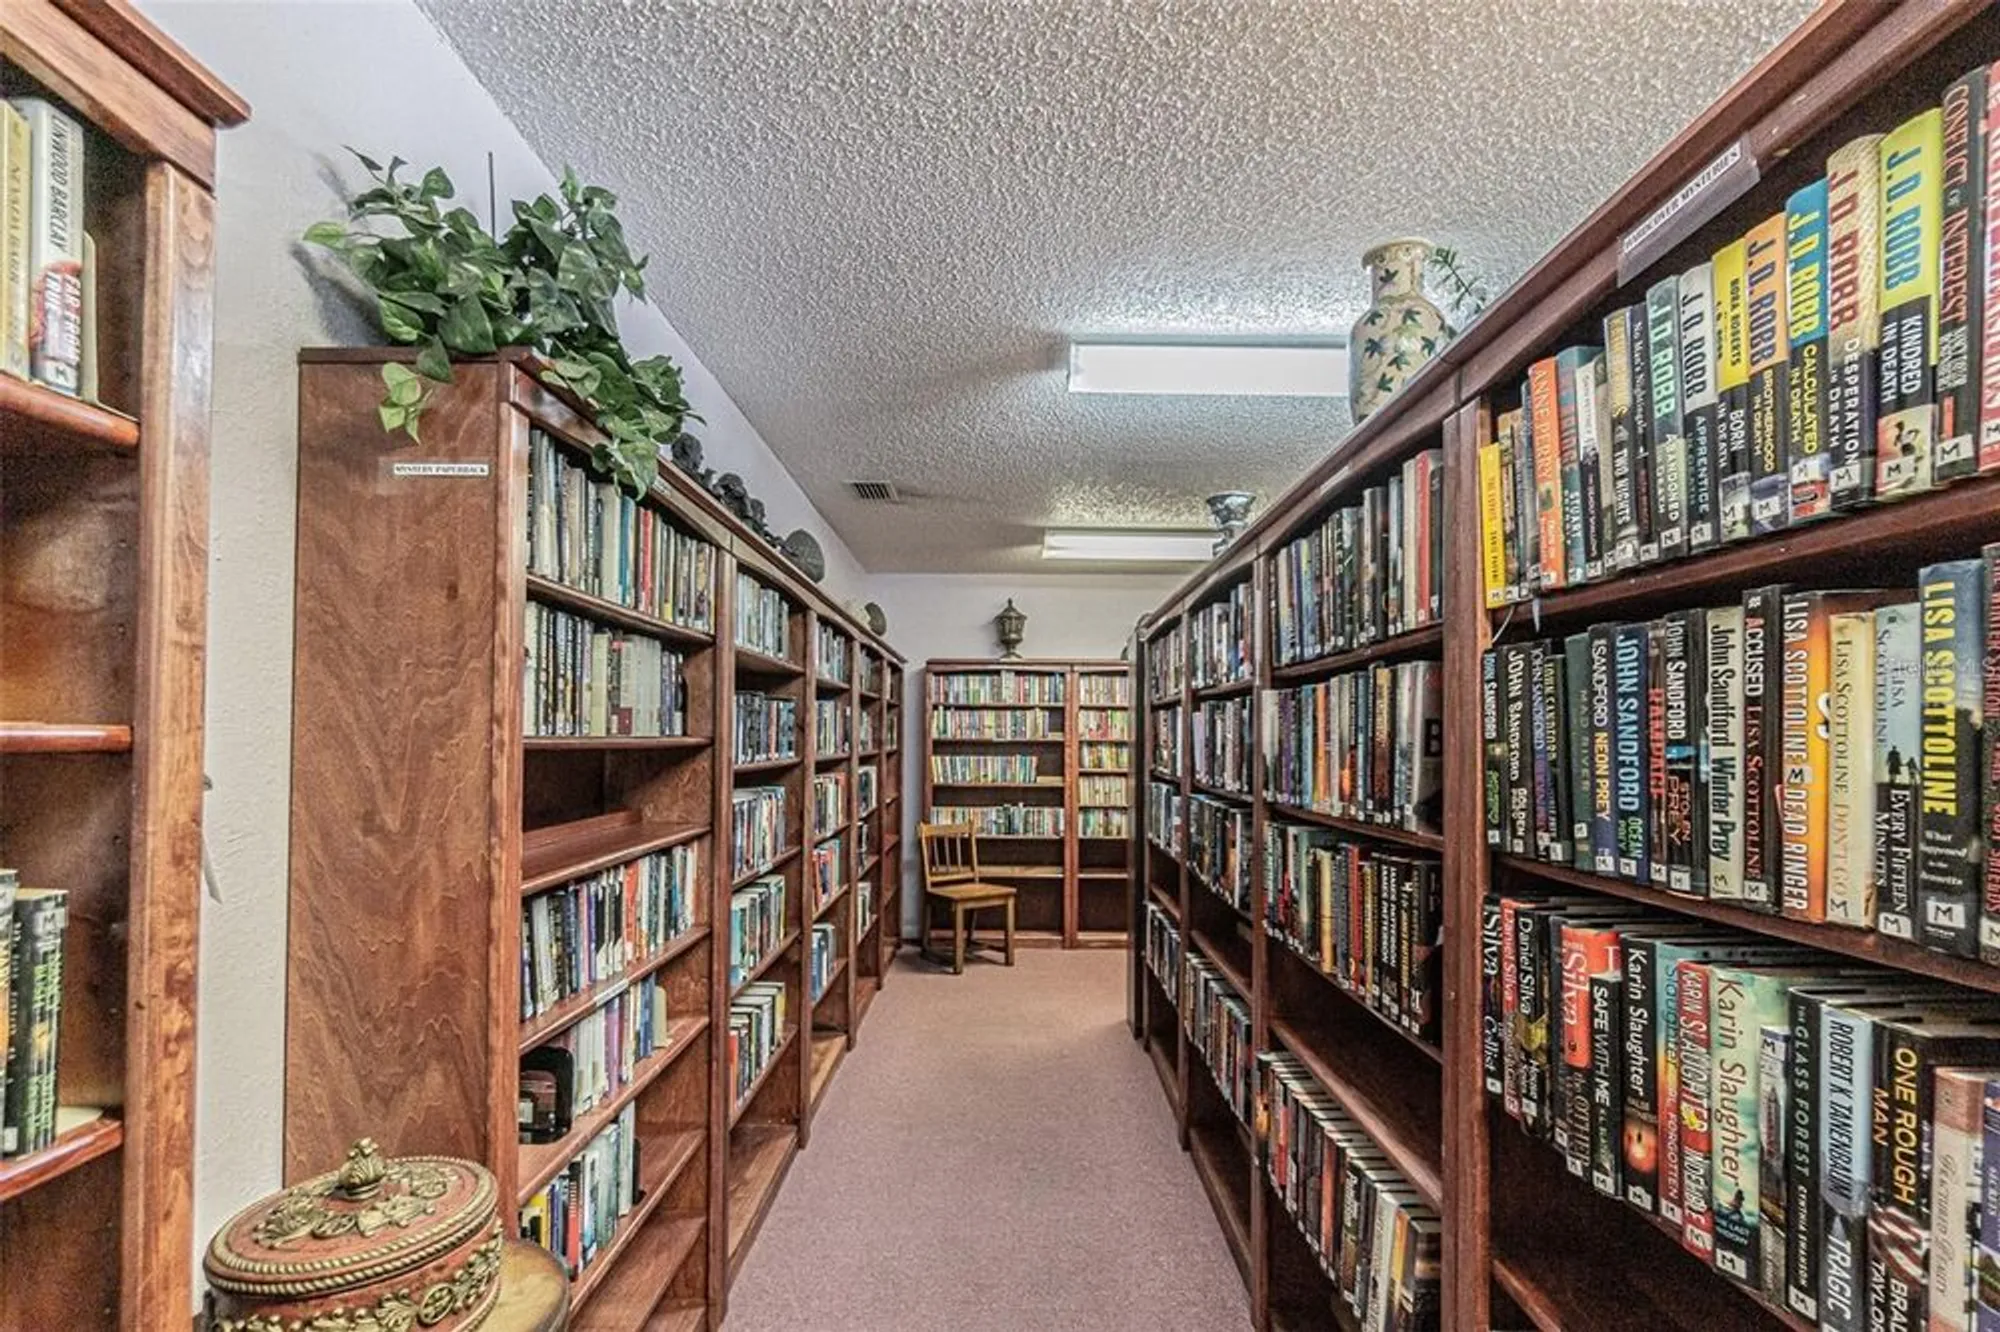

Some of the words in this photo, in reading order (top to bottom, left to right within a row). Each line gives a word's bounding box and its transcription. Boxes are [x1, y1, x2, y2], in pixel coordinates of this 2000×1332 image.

[50, 114, 69, 182] LINWOOD
[1943, 85, 1969, 190] CONFLICT
[50, 184, 69, 252] BARCLAY
[1885, 204, 1921, 291] ROBB
[45, 271, 61, 312] TRUE
[63, 274, 81, 307] FAR
[1829, 229, 1860, 332] ROBB
[1941, 206, 1969, 323] INTEREST
[1749, 290, 1777, 368] ROBB
[1790, 262, 1821, 340] ROBB
[1883, 322, 1897, 345] IN
[1899, 313, 1924, 396] KINDRED
[1533, 369, 1552, 418] ANNE
[1652, 344, 1676, 420] ROBB
[1684, 338, 1708, 400] ROBB
[1791, 367, 1801, 385] IN
[1803, 342, 1819, 455] CALCULATED
[1882, 348, 1898, 404] DEATH
[1718, 401, 1728, 415] IN
[1730, 408, 1746, 452] BORN
[1754, 394, 1762, 411] IN
[1763, 368, 1775, 473] BROTHERHOOD
[1790, 388, 1802, 444] DEATH
[1830, 387, 1841, 448] DEATH
[1842, 338, 1861, 467] DESPERATION
[1535, 420, 1554, 483] PERRY
[1614, 448, 1630, 474] TWO
[1695, 415, 1710, 514] APPRENTICE
[1719, 418, 1729, 468] DEATH
[1754, 413, 1763, 458] DEATH
[1614, 477, 1632, 526] NIGHTS
[1665, 433, 1680, 522] ABANDONED
[1569, 489, 1582, 539] STUART
[1666, 620, 1685, 658] JOHN
[1783, 600, 1809, 644] LISA
[1922, 581, 1956, 643] LISA
[1483, 653, 1497, 680] JOHN
[1507, 650, 1524, 699] JOHN
[1530, 648, 1544, 682] JOHN
[1615, 635, 1640, 692] JOHN
[1710, 624, 1737, 667] John
[1744, 616, 1764, 696] ACCUSED
[1834, 639, 1853, 680] LISA
[1483, 682, 1498, 740] SANDFORD
[1532, 684, 1545, 750] SANDFORD
[1592, 648, 1609, 727] SANDFORD
[1667, 661, 1688, 740] SANDFORD
[1711, 669, 1737, 748] Sandford
[1783, 650, 1808, 760] SCOTTOLINE
[1875, 628, 1891, 748] SCOTTOLINE
[1508, 700, 1524, 781] SANDFORD
[1595, 732, 1609, 777] NEON
[1617, 697, 1641, 811] SANDFORD
[1745, 705, 1762, 748] LISA
[1834, 682, 1852, 795] SCOTTOLINE
[1922, 650, 1958, 818] SCOTTOLINE
[1580, 735, 1590, 792] RIVER
[1712, 753, 1738, 817] Winter
[1516, 787, 1528, 837] GOLDEN
[1596, 778, 1610, 821] PREY
[1667, 776, 1682, 845] PREY
[1679, 782, 1691, 842] STOLEN
[1745, 754, 1763, 879] SCOTTOLINE
[1783, 788, 1808, 835] DEAD
[1889, 788, 1910, 843] EVERY
[1628, 817, 1643, 859] OCEAN
[1711, 820, 1738, 862] Prey
[1875, 811, 1890, 887] MINUTES
[1783, 841, 1808, 910] RINGER
[1832, 863, 1849, 898] GO
[1892, 845, 1913, 915] FIFTEEN
[1504, 908, 1516, 961] Daniel
[1934, 904, 1954, 922] M
[1484, 911, 1502, 976] Silva
[1518, 917, 1534, 970] Daniel
[1504, 963, 1516, 1001] Silva
[1519, 973, 1535, 1014] Silva
[1562, 950, 1589, 1026] Silva
[1626, 948, 1646, 1000] Karin
[1681, 968, 1702, 1012] KARIN
[1593, 985, 1609, 1031] SAFE
[1717, 977, 1743, 1050] Karin
[1484, 1015, 1499, 1072] Cellist
[1593, 1032, 1609, 1077] WITH
[1625, 1005, 1647, 1097] Slaughter
[1794, 1025, 1810, 1090] GLASS
[1830, 1019, 1854, 1082] ROBERT
[1528, 1057, 1540, 1099] House
[1573, 1072, 1586, 1093] the
[1594, 1078, 1610, 1107] ME
[1681, 1016, 1709, 1134] SLAUGHTER
[1894, 1047, 1918, 1105] ONE
[1575, 1096, 1591, 1166] OTHER
[1714, 1059, 1747, 1186] Slaughter
[1794, 1097, 1811, 1178] FOREST
[1873, 1087, 1889, 1146] MAN
[1667, 1111, 1680, 1199] FORGOTTEN
[1829, 1100, 1853, 1200] TANENBAUM
[1893, 1108, 1917, 1205] ROUGH
[1796, 1184, 1808, 1232] CYNTHIA
[1796, 1234, 1808, 1287] SWANSON
[1827, 1234, 1852, 1321] TRAGIC
